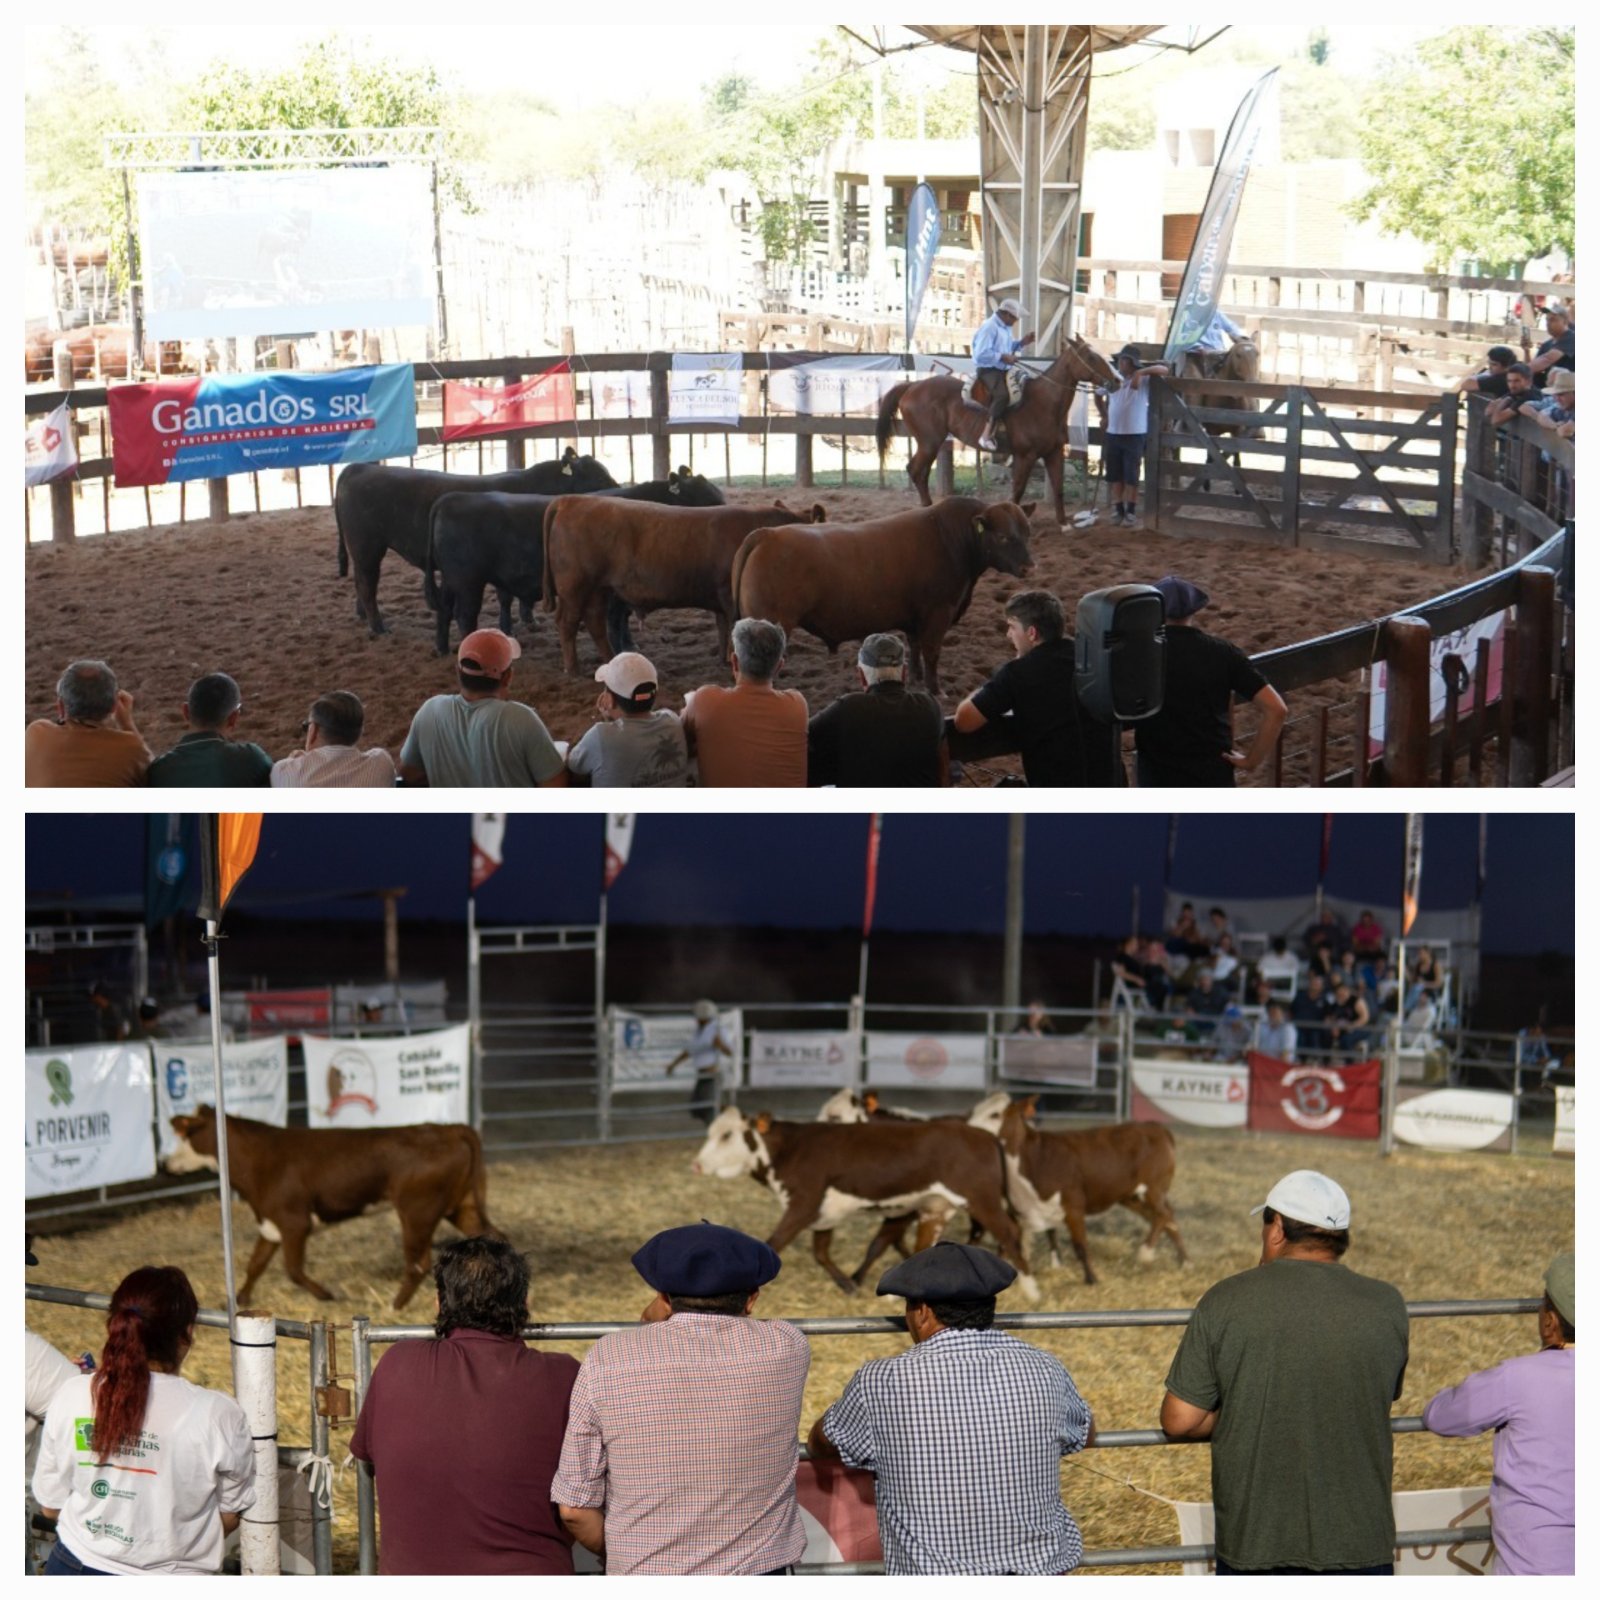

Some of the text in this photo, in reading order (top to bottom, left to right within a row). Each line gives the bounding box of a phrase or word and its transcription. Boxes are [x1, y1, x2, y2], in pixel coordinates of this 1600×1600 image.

[151, 388, 374, 434] Ganados SRL
[162, 422, 367, 448] CONSIGNATARIOS DE HACIENDA
[1162, 1077, 1223, 1094] KAYNE
[36, 1112, 111, 1144] PORVENIR
